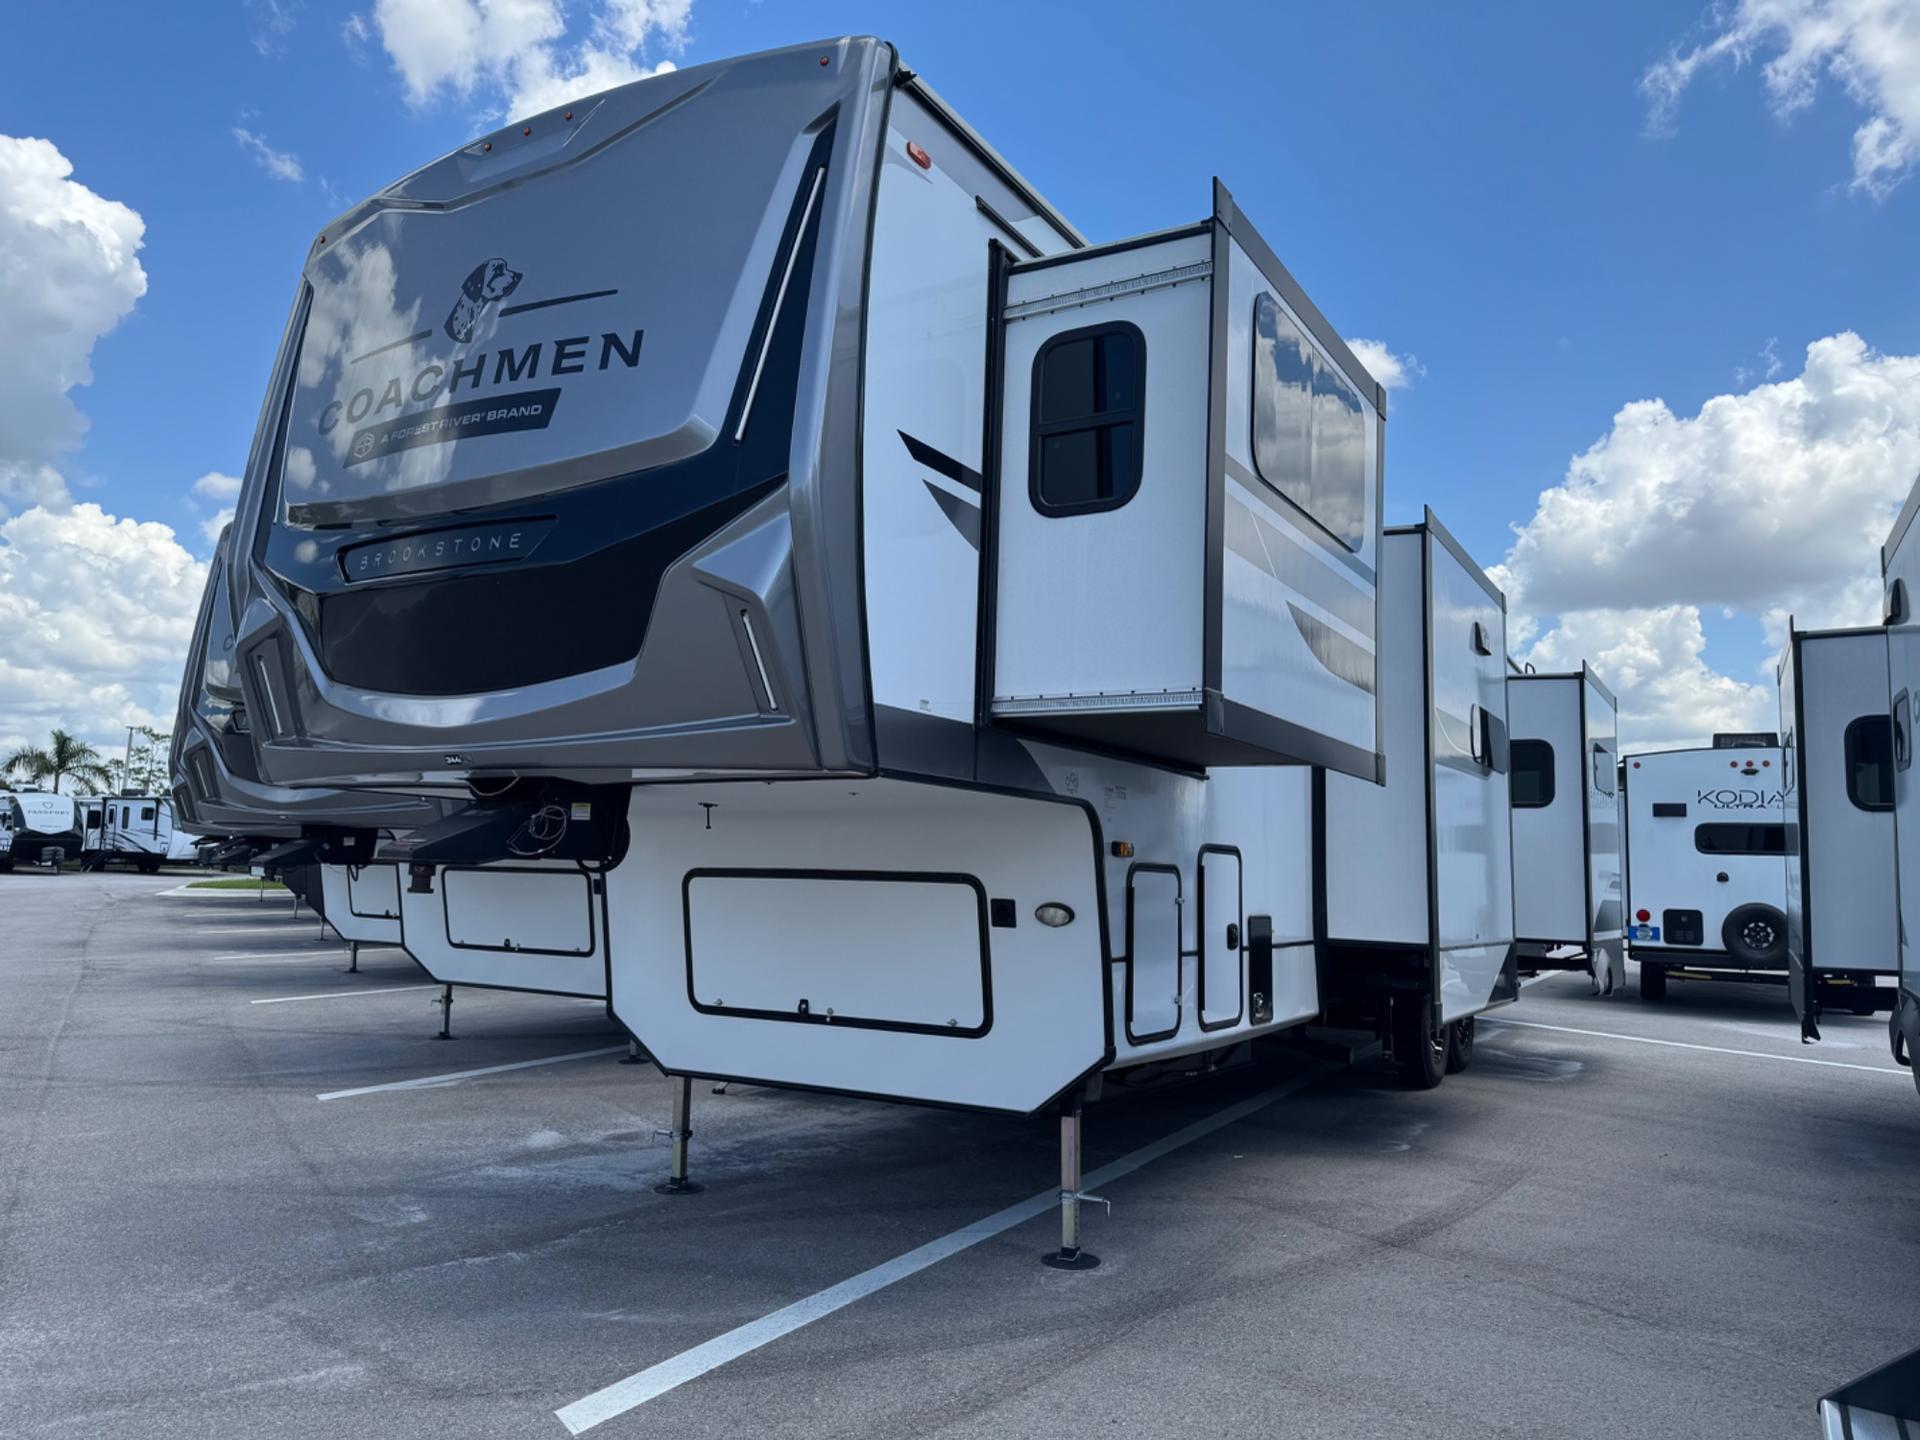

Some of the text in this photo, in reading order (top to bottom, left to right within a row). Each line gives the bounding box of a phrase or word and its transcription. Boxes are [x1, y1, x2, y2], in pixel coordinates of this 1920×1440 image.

[318, 329, 645, 436] COACHMEN
[380, 434, 390, 443] A
[486, 404, 543, 421] BRAND
[359, 532, 522, 571] BROOKSTONE
[1697, 789, 1785, 805] KODIA
